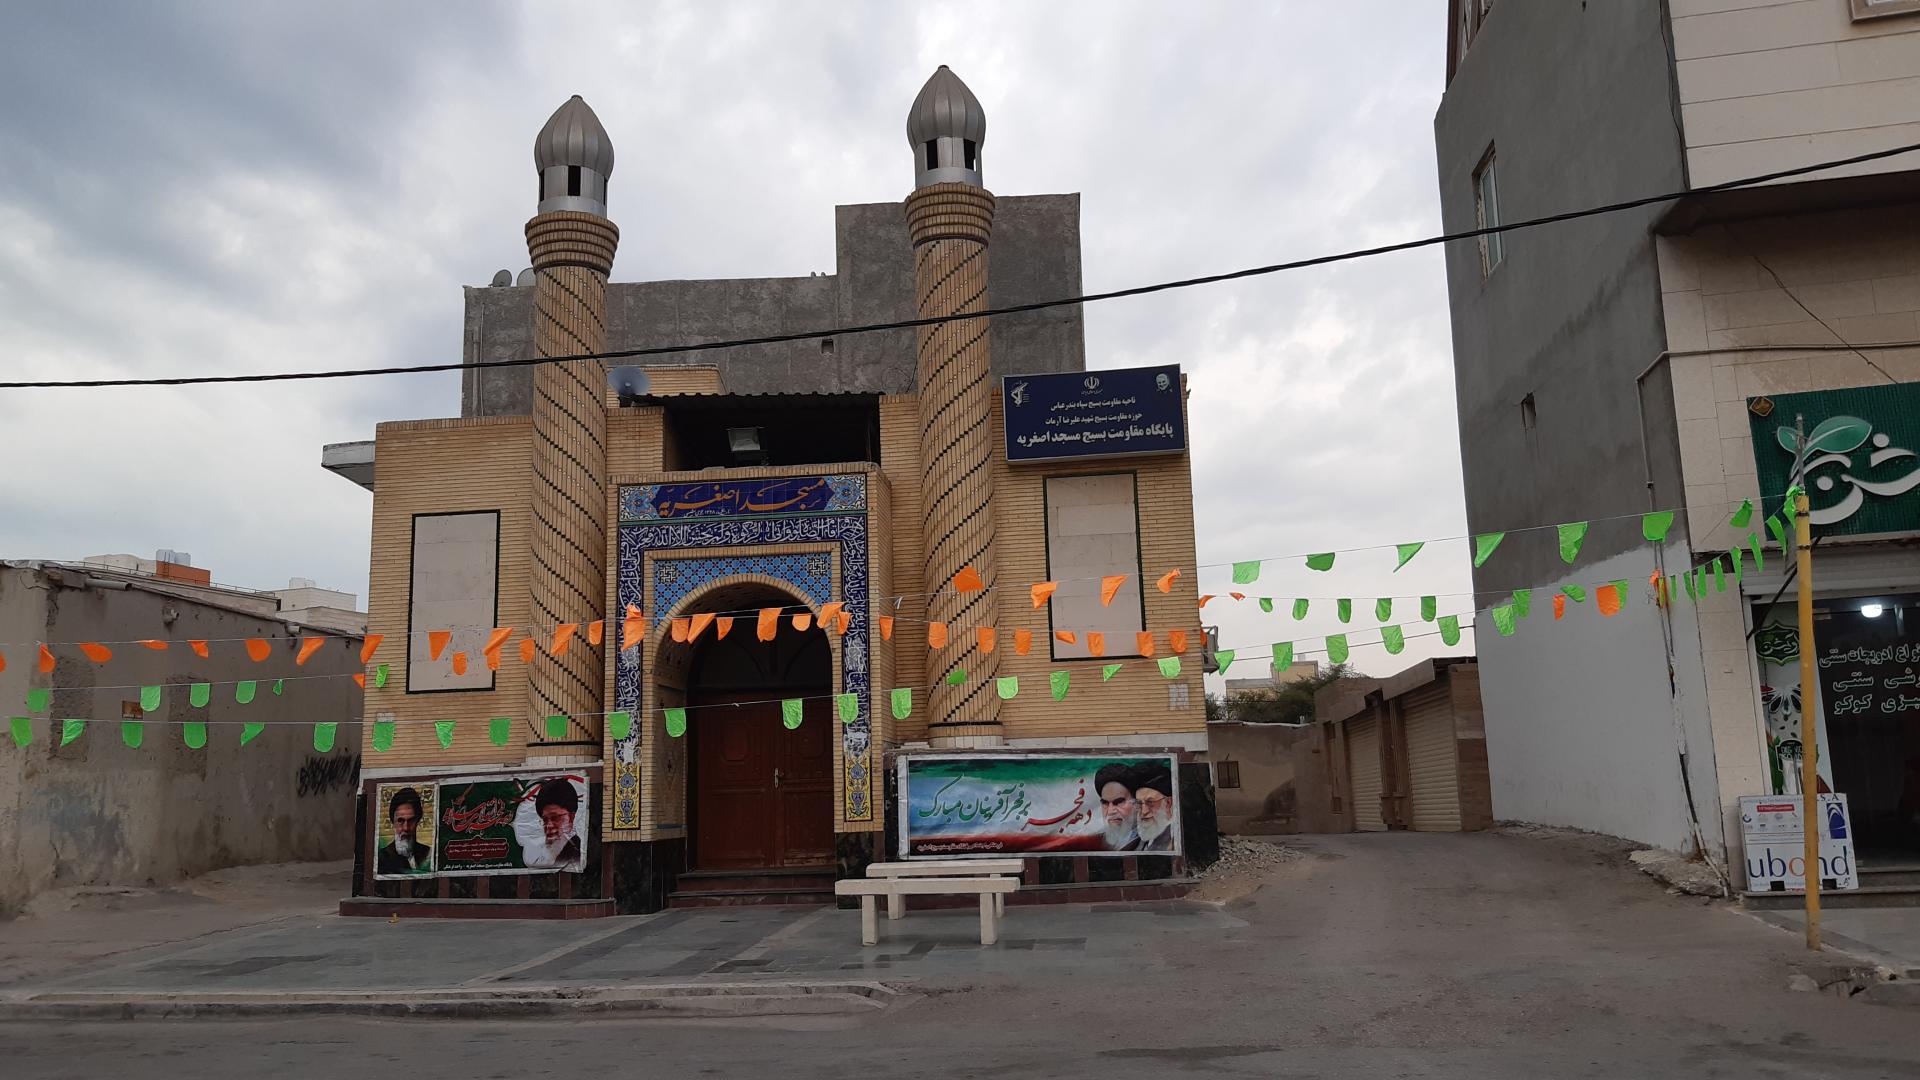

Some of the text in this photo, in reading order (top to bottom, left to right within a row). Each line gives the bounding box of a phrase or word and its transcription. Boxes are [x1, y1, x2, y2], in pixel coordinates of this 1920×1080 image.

[1076, 401, 1088, 409] سپاه
[1088, 400, 1102, 409] بسیج
[1102, 398, 1122, 408] مقاومت
[1122, 396, 1136, 405] ناحیه
[1062, 416, 1081, 425] علیرضا
[1081, 415, 1094, 423] شهید
[1094, 415, 1108, 423] بسیج
[1108, 414, 1128, 422] مقاومت
[1128, 412, 1143, 421] حوزه
[1016, 422, 1174, 448] پایگاه مقاومت بسیج مسجد اصغریه
[739, 479, 826, 512] مسجد
[1819, 648, 1847, 668] سنتی
[1847, 645, 1893, 665] ادویجات
[1832, 671, 1874, 692] سنتی
[1833, 694, 1920, 714] بزی کوکو
[919, 773, 965, 823] مبارک
[1021, 778, 1092, 833] دهه فجر
[1747, 845, 1850, 879] ubond
